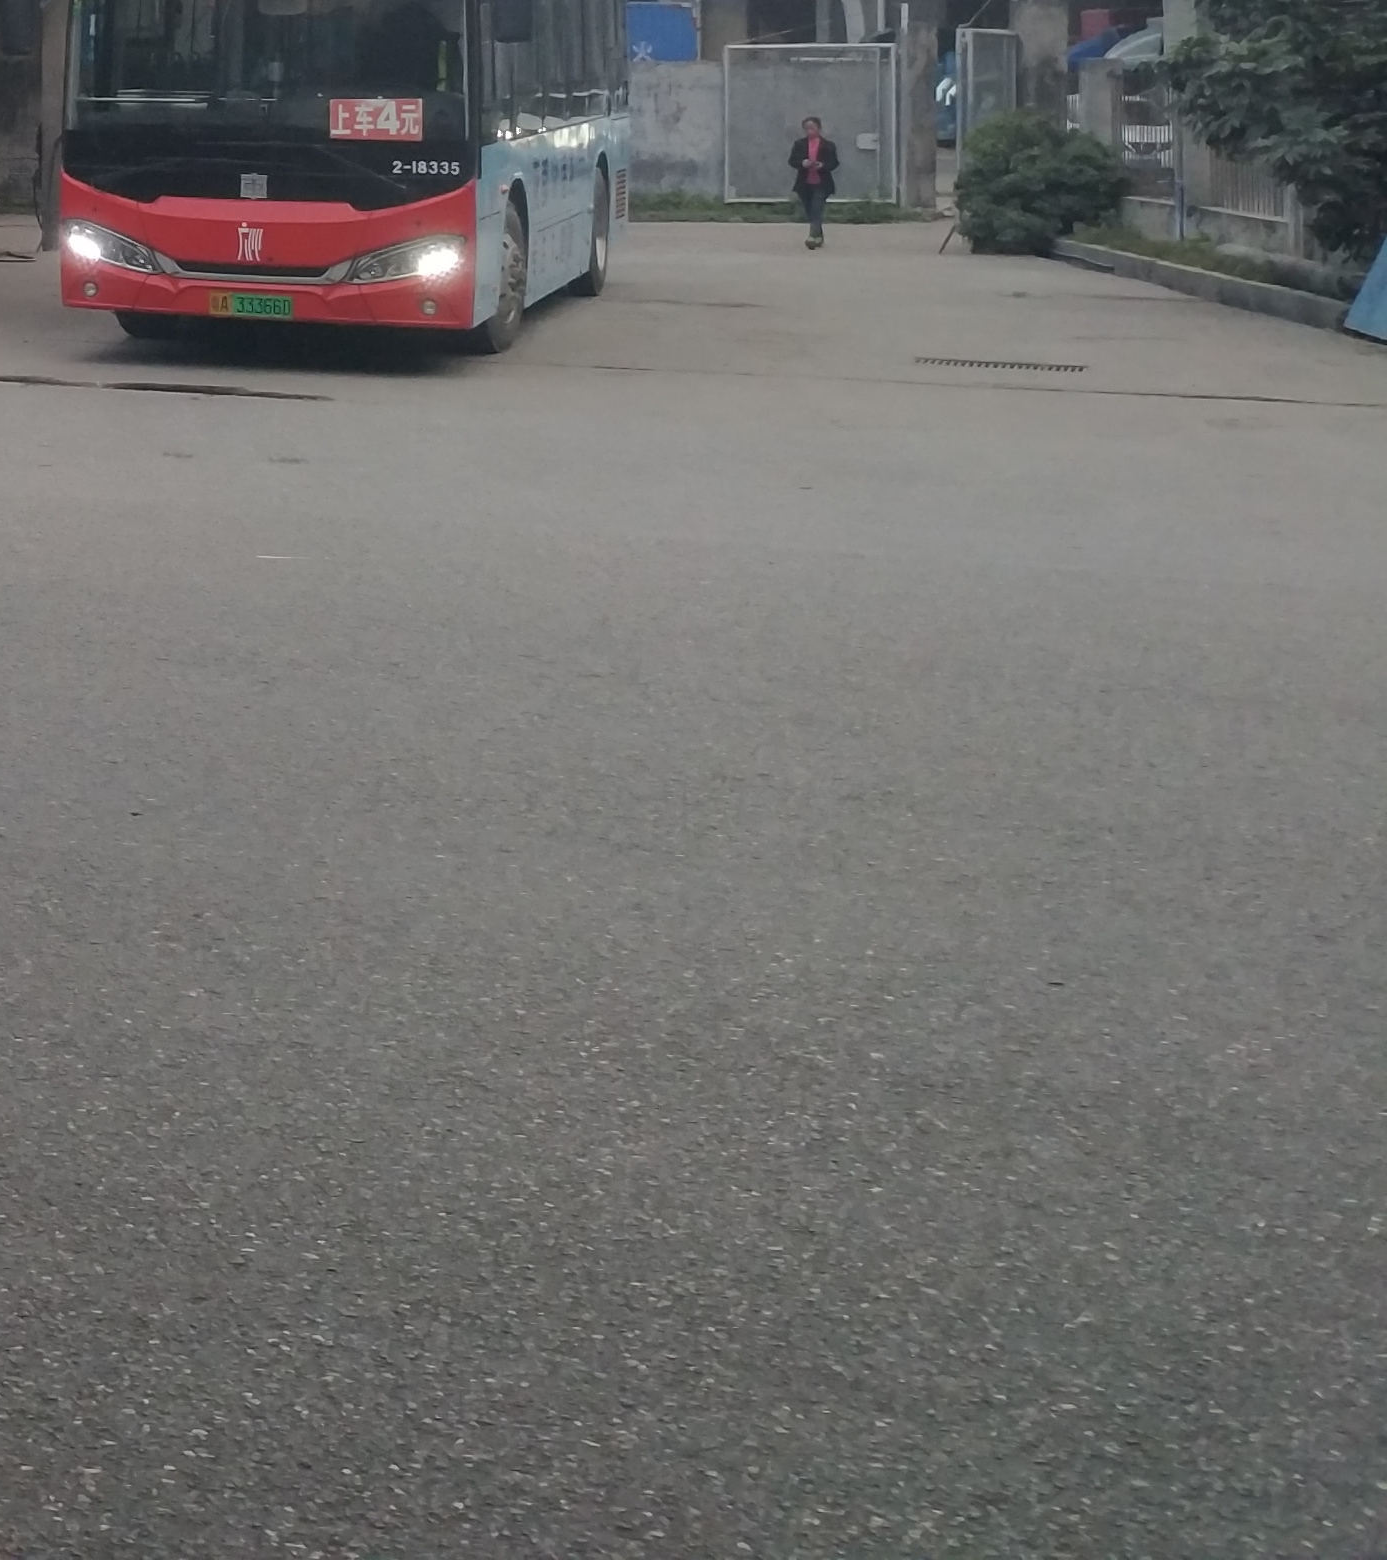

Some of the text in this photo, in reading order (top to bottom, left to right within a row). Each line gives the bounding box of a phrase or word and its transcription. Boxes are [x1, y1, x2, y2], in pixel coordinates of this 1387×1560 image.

[330, 100, 420, 137] 上车4元
[392, 160, 460, 175] 2-18335
